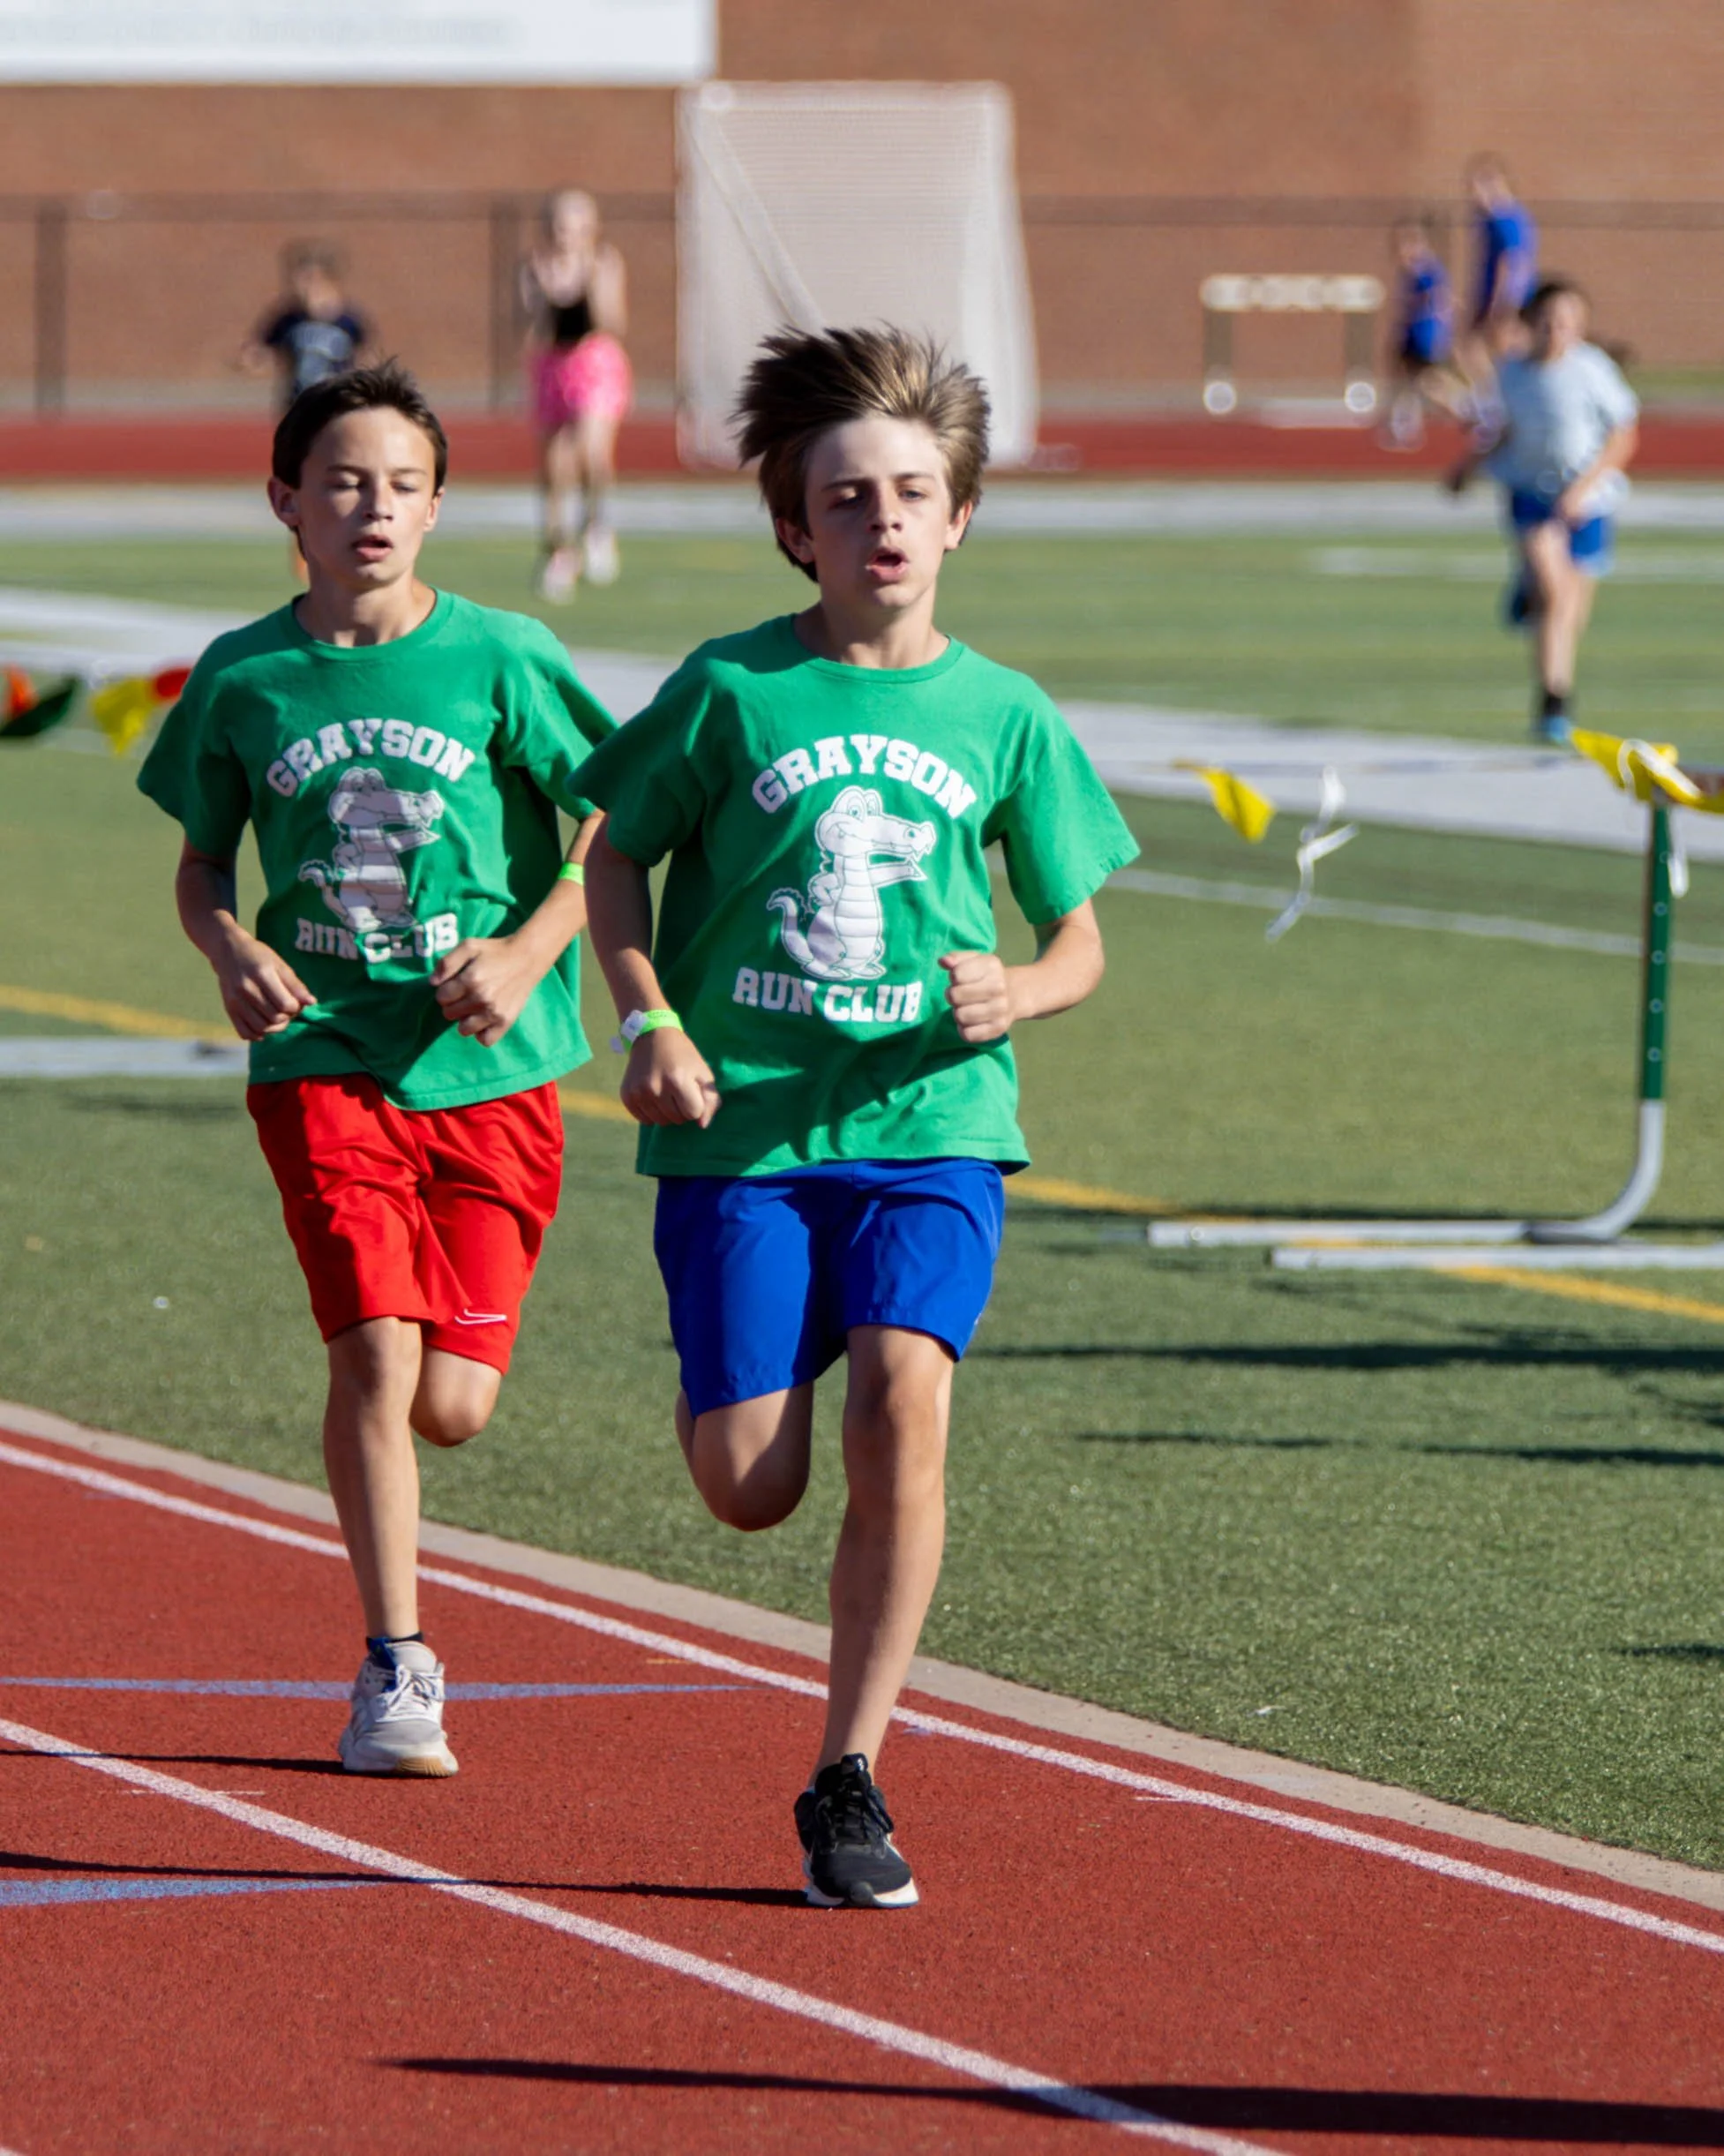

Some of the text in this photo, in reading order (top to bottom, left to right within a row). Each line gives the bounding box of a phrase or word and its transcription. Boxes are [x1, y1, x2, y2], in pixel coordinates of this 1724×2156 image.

[266, 717, 475, 797] GRAYSON
[752, 734, 976, 819] GRAYSON
[295, 912, 459, 964] RUN CLUB
[732, 967, 923, 1022] RUN CLUB
